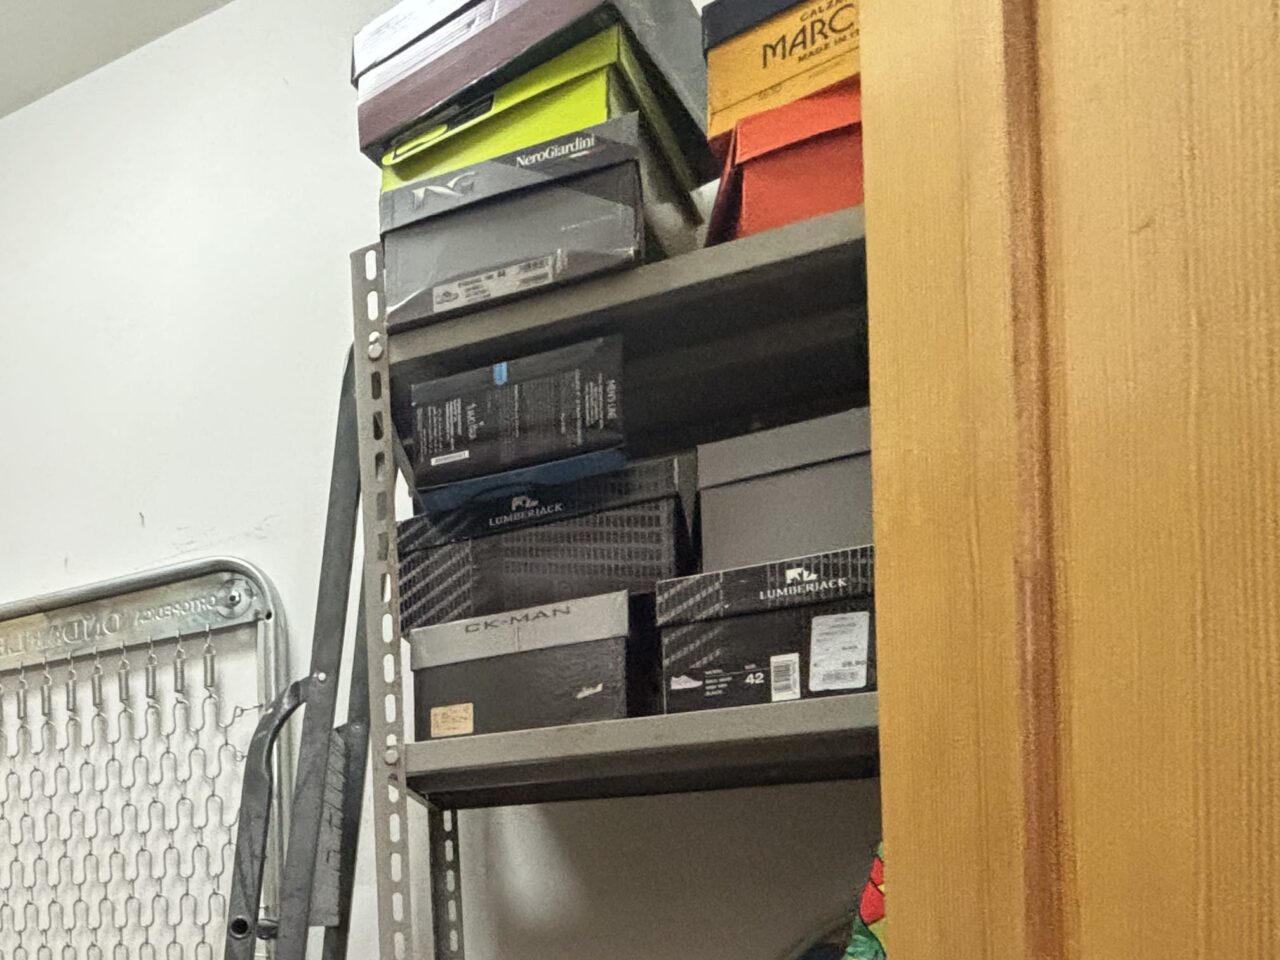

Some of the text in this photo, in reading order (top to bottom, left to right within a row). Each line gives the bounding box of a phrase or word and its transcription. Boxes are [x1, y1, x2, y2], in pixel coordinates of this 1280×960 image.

[762, 3, 857, 69] MARC
[515, 133, 596, 168] NeroGiardini
[488, 503, 564, 527] LUMBERJACK
[759, 576, 848, 601] LUMBERJACK
[464, 605, 571, 634] CK-MAN
[744, 672, 765, 685] 42
